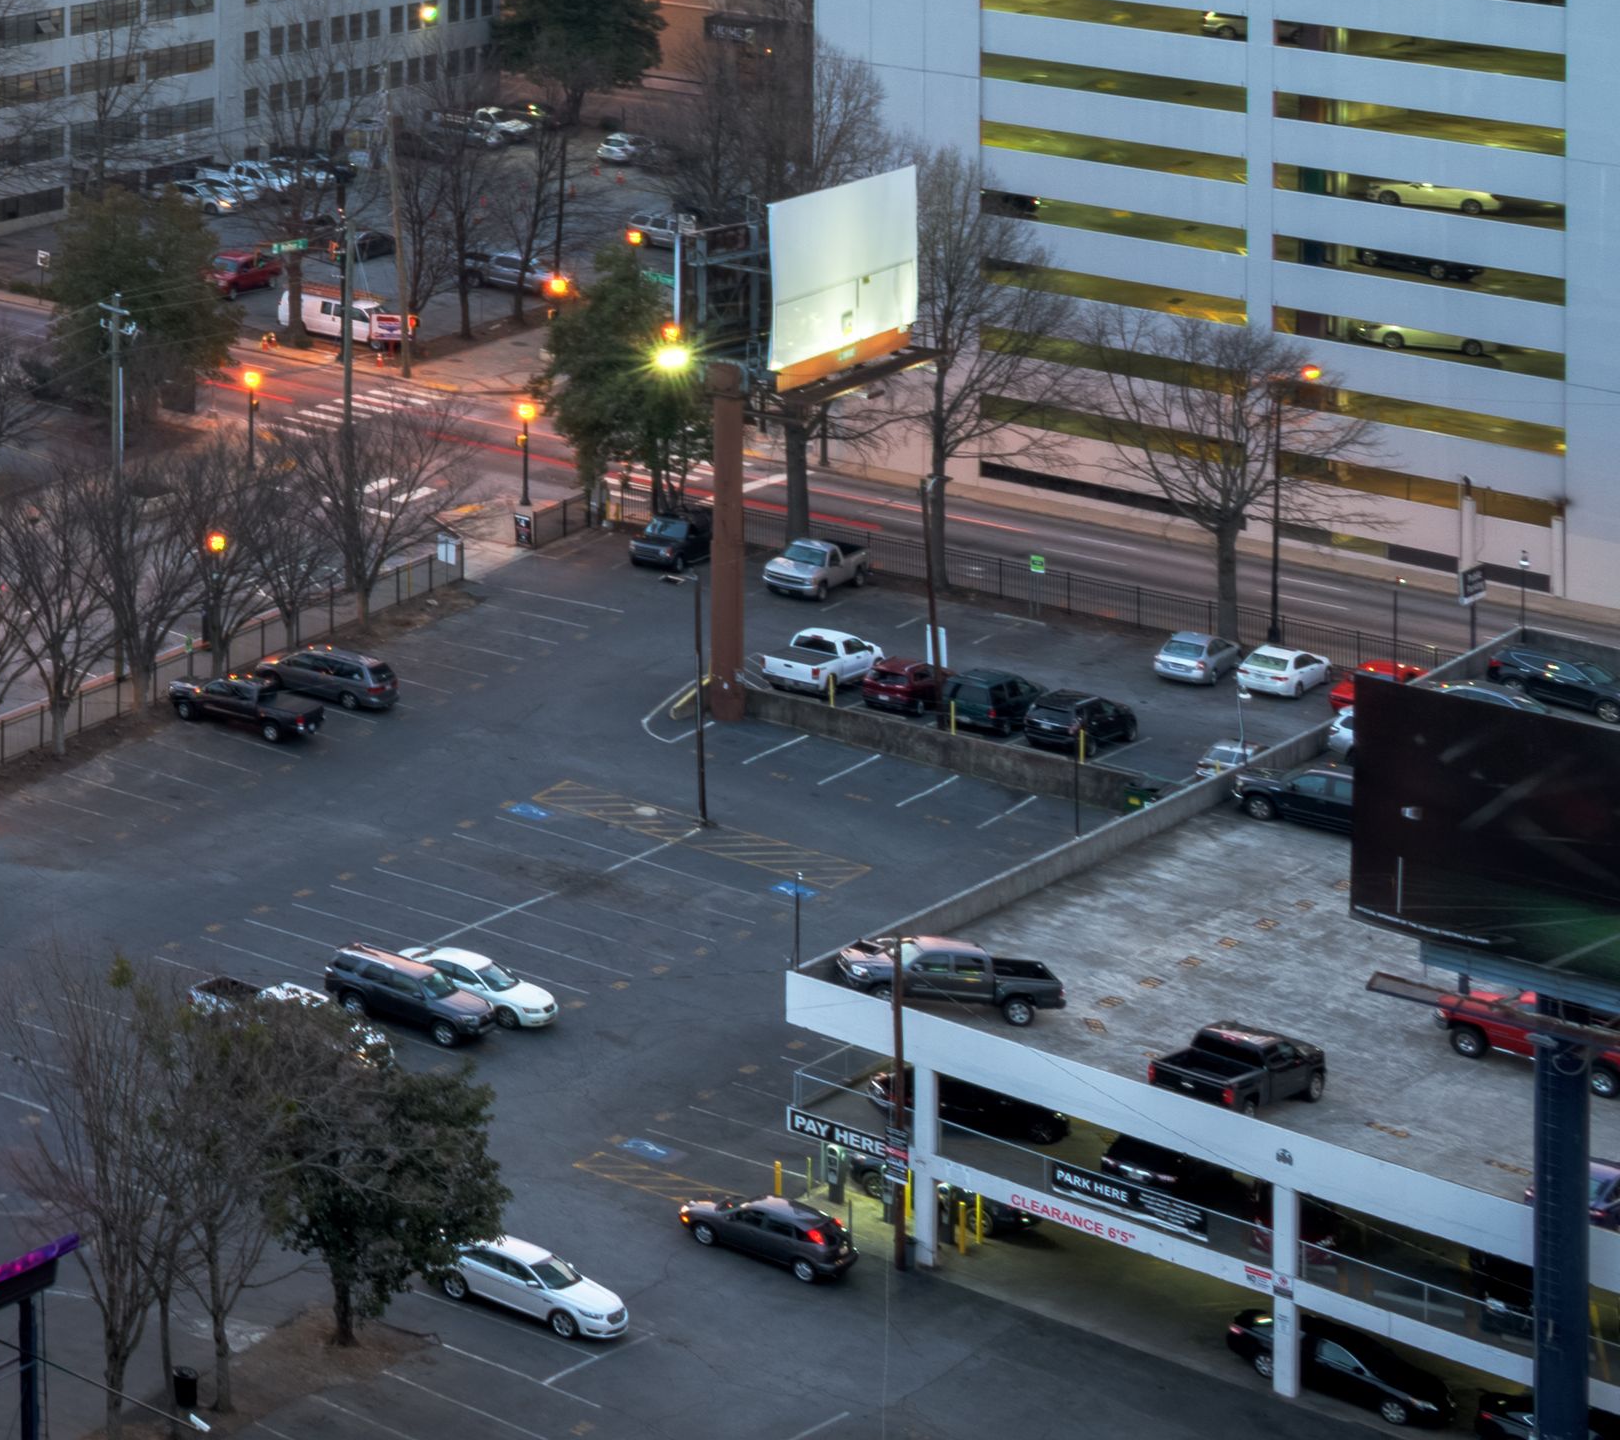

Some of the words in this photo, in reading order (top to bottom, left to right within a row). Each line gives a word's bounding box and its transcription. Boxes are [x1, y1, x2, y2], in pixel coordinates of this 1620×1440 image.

[793, 1114, 830, 1138] PAY
[834, 1127, 886, 1157] HERE
[1056, 1169, 1091, 1191] PARK
[1093, 1181, 1129, 1203] HERE
[1010, 1193, 1104, 1235] CLEARANCE
[1108, 1227, 1136, 1243] 6'5"
